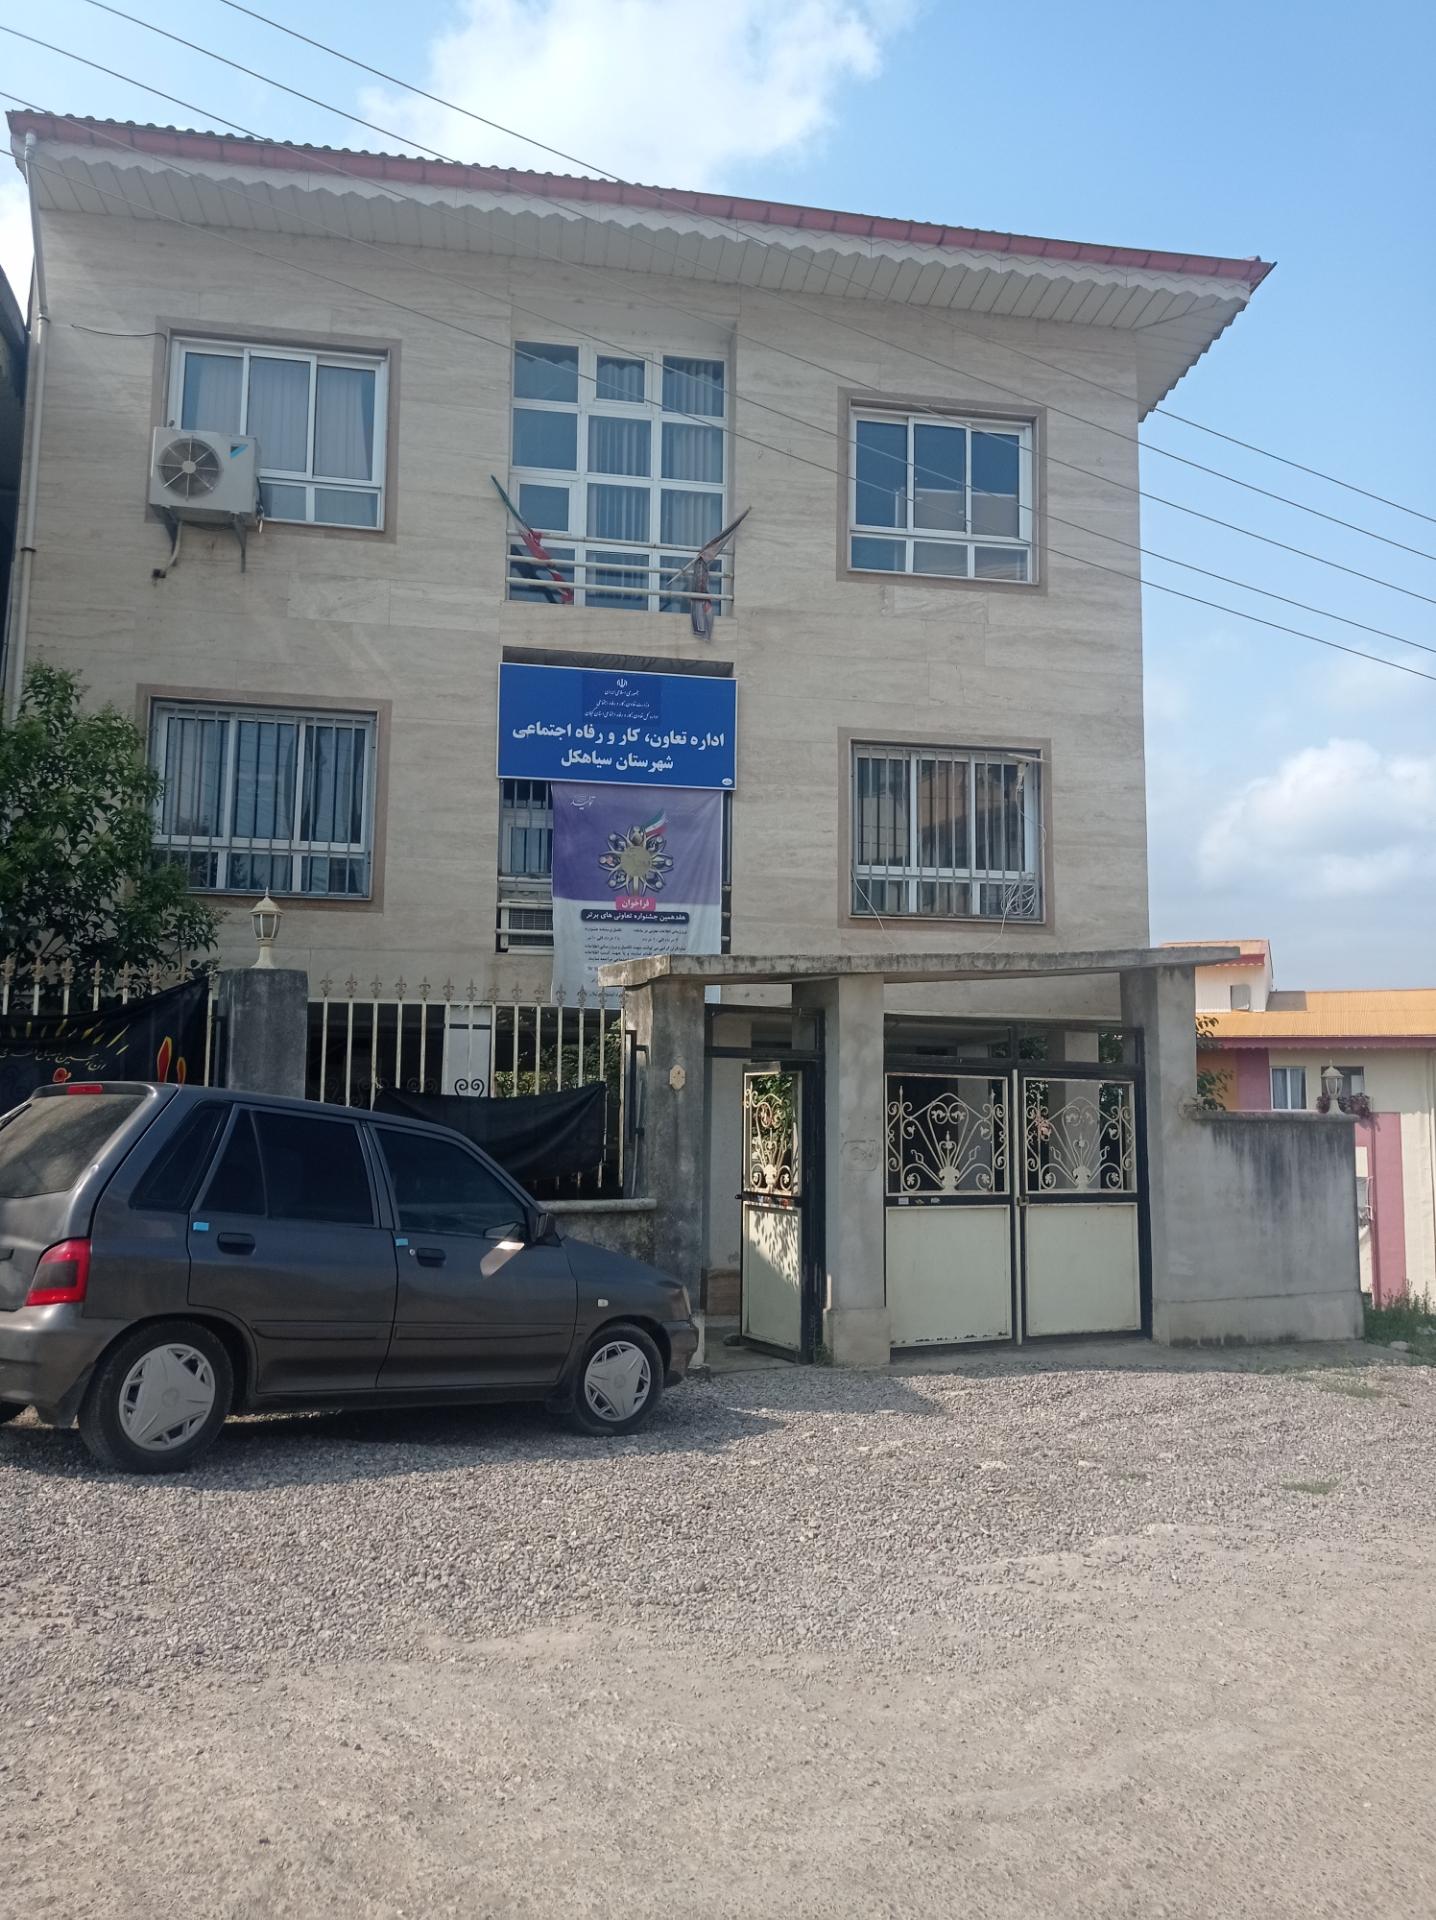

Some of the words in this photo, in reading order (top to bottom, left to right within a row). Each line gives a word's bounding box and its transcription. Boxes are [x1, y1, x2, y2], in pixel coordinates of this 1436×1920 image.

[512, 722, 572, 741] اجتماعی
[575, 724, 604, 744] رفاه
[608, 732, 616, 744] و
[619, 727, 641, 747] کار
[644, 730, 688, 749] تعاون،
[690, 732, 725, 751] اداره
[561, 748, 613, 769] سیاهکل
[615, 752, 674, 773] شهرستان
[622, 898, 649, 908] فراخوان
[585, 911, 600, 919] برتر
[600, 911, 613, 919] های
[613, 912, 633, 920] تعاونی
[633, 912, 658, 921] جشنواره
[659, 913, 686, 922] هفدهمین
